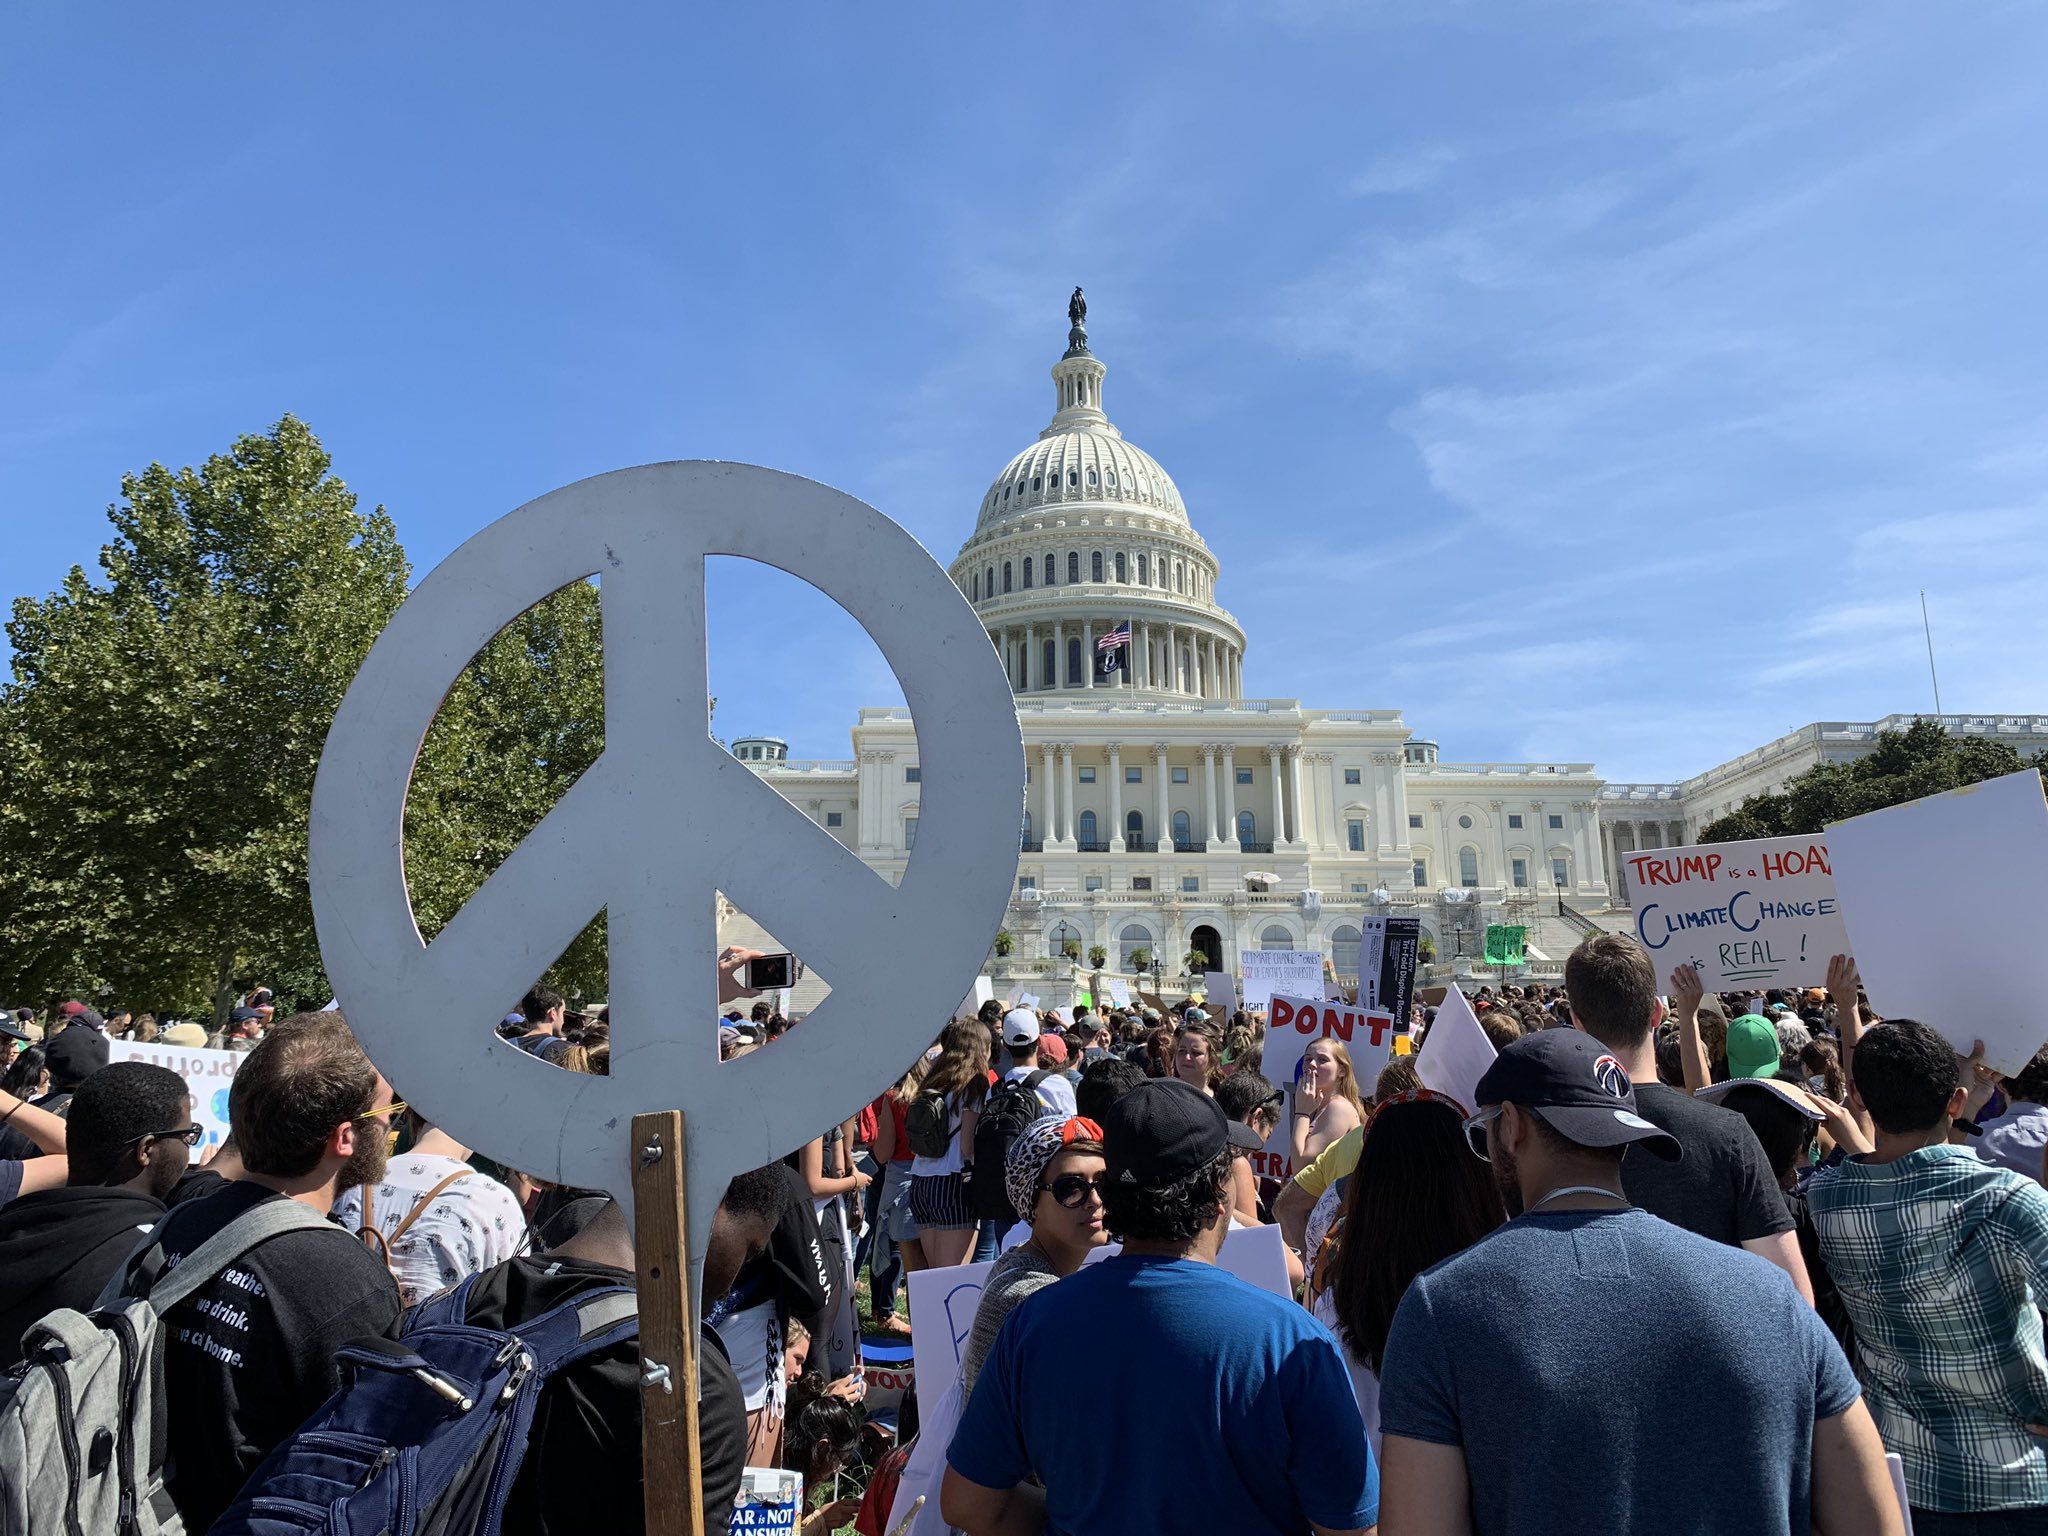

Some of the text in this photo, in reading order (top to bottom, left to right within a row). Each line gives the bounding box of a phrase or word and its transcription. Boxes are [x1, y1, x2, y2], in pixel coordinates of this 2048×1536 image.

[1627, 854, 1722, 885] TRUMP
[1728, 866, 1741, 879] is
[1747, 868, 1757, 878] a
[1638, 891, 1836, 949] CLIMATE CHANGE
[1242, 952, 1272, 964] CLIMATE
[1690, 956, 1705, 971] is
[1719, 940, 1786, 969] REAL
[1396, 939, 1410, 1024] Tri-Fold Display Board
[1271, 998, 1391, 1047] DON'T
[220, 1268, 266, 1298] reathe.
[209, 1300, 249, 1332] drink.
[203, 1334, 244, 1368] home.
[729, 1508, 794, 1525] AR is NOT
